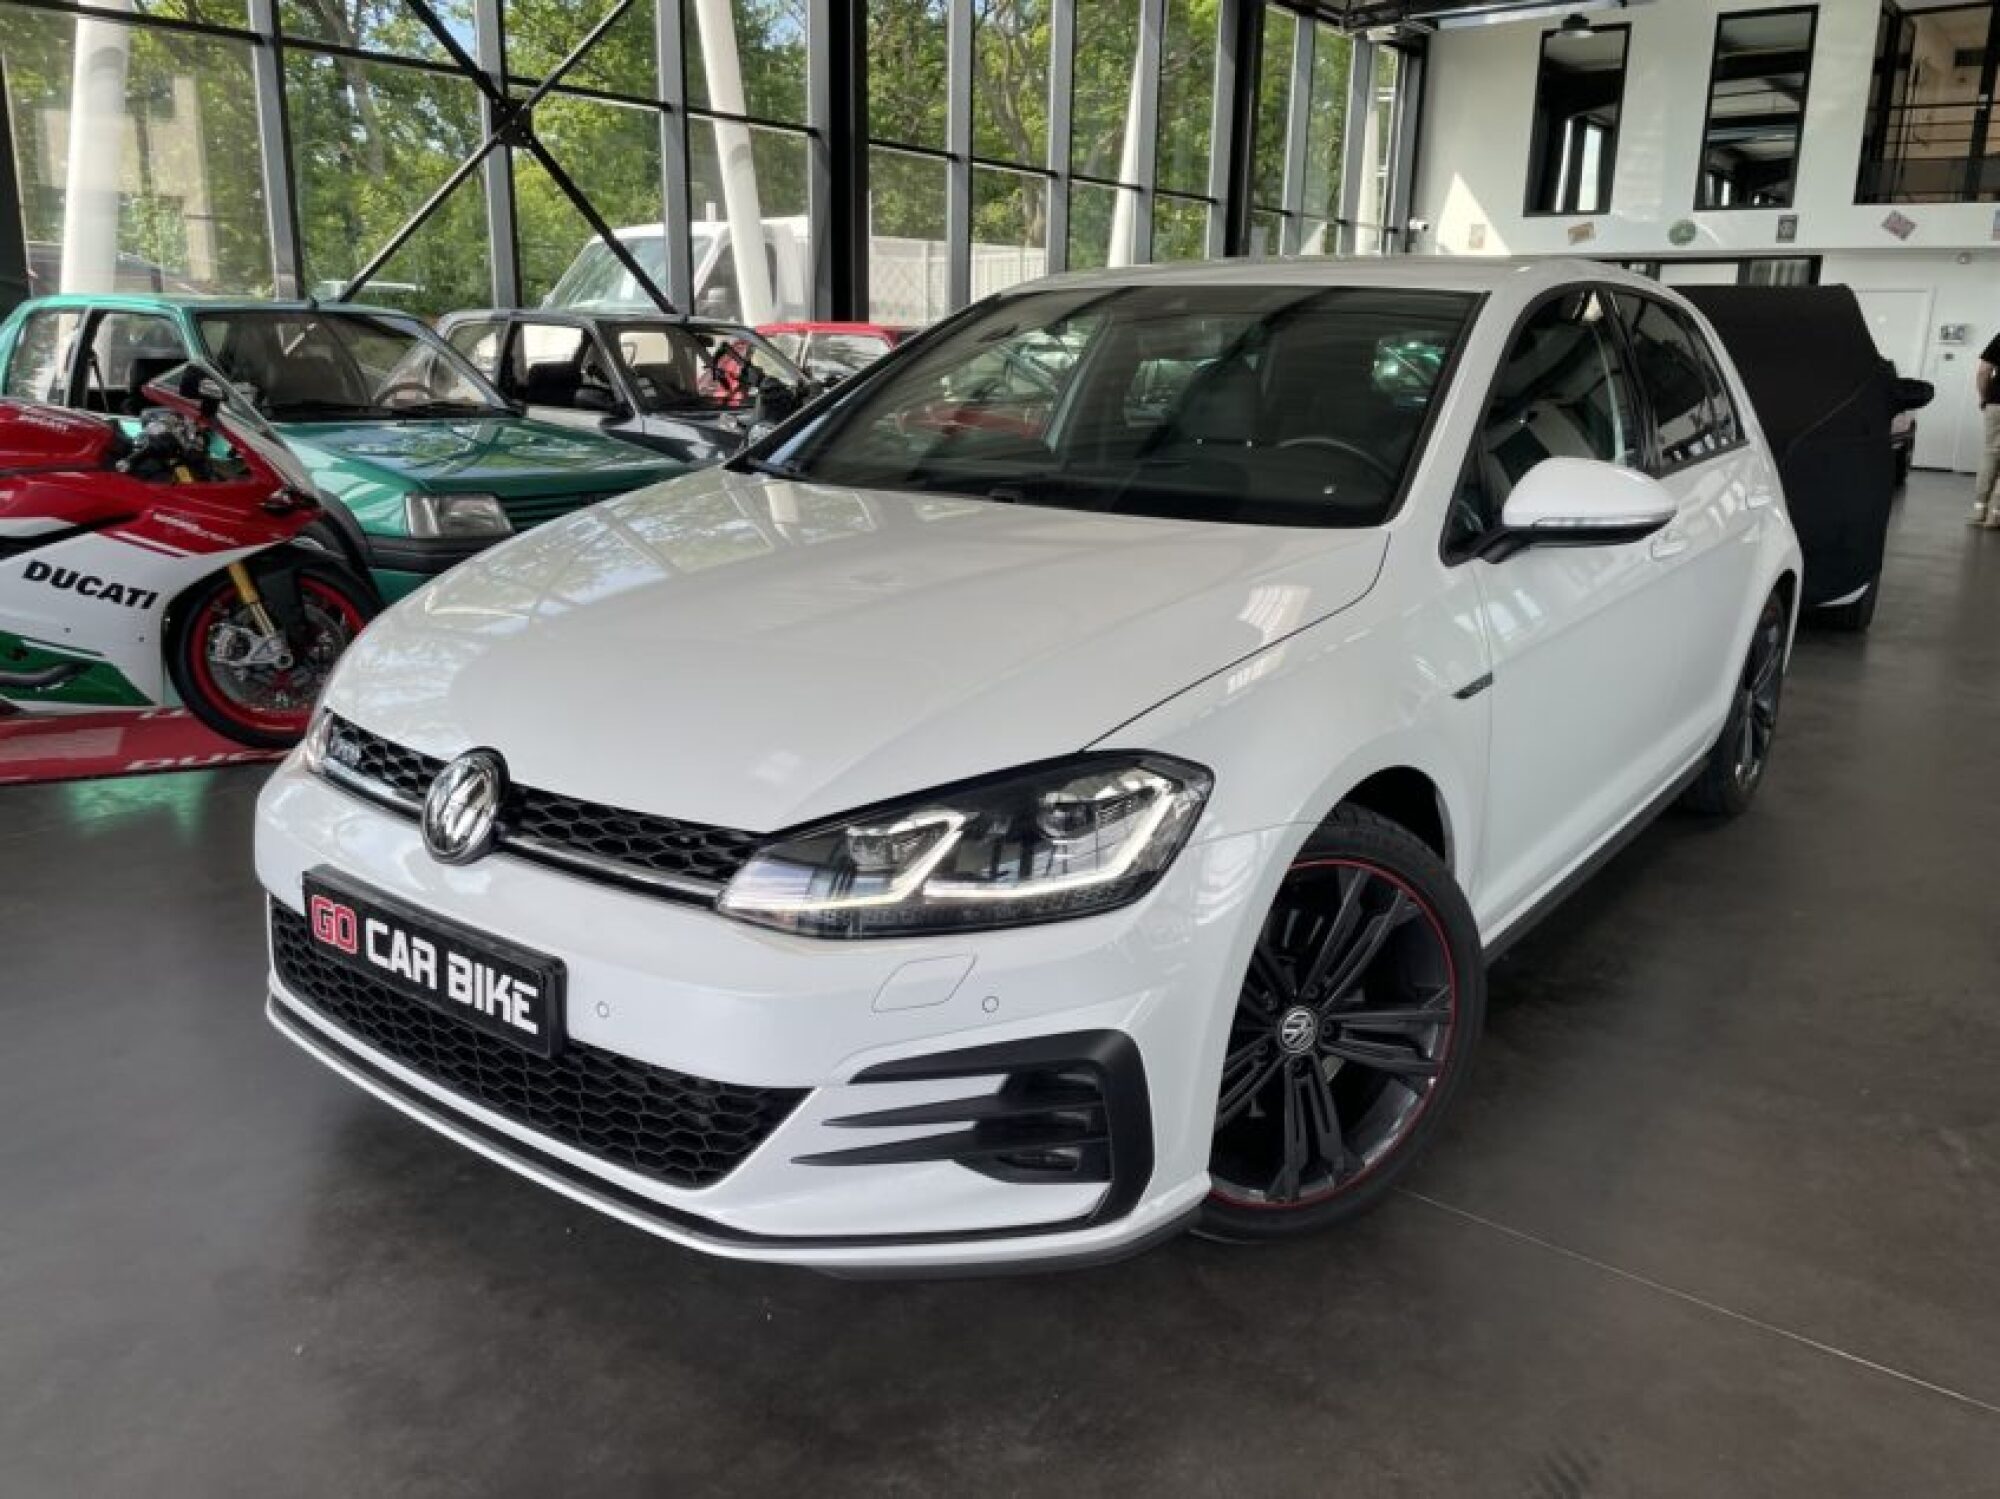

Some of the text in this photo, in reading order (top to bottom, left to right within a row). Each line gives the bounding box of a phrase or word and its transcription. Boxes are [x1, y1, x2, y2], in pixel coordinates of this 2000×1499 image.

[23, 561, 158, 609] DUCATI
[312, 895, 538, 1035] GO CAR BIKE
